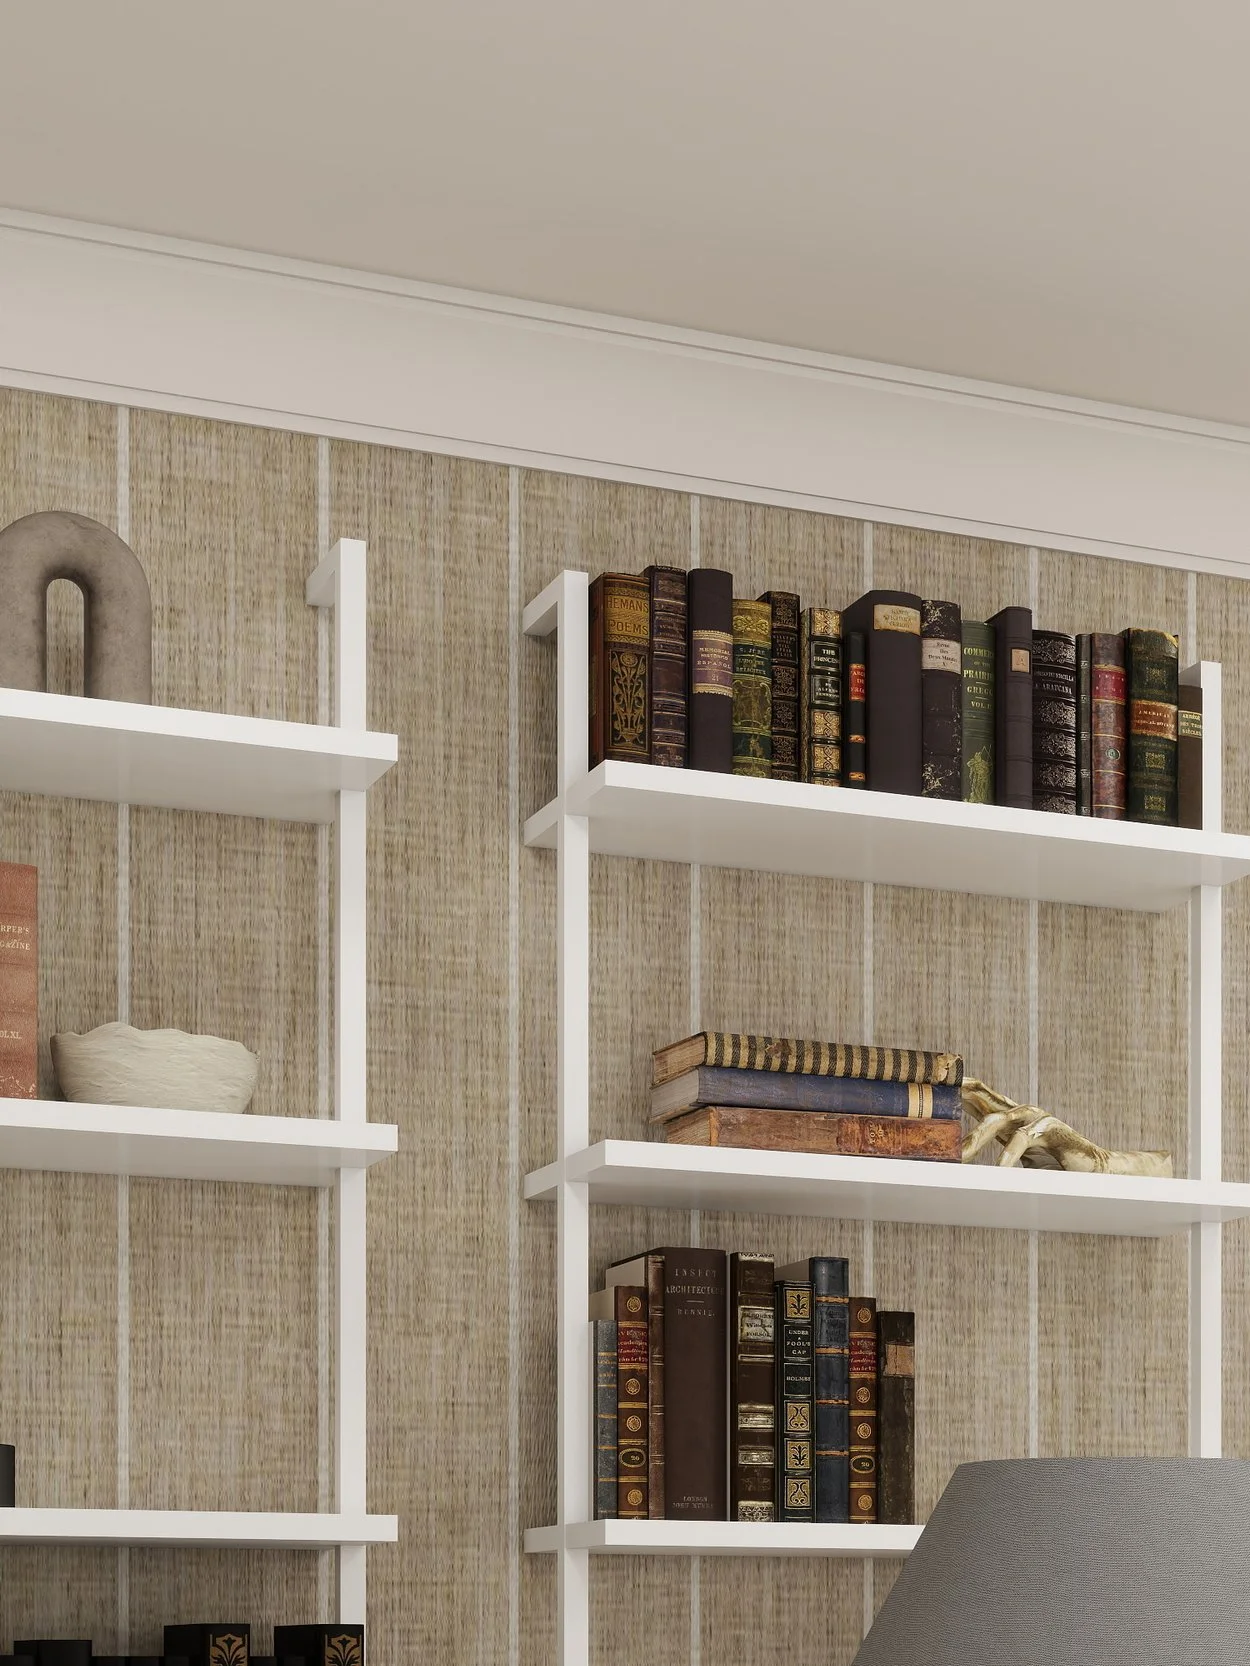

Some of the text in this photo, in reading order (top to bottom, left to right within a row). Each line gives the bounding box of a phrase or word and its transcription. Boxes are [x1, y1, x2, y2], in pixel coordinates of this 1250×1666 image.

[607, 597, 649, 613] HEMANS
[608, 620, 648, 635] POEMS
[0, 925, 29, 934] RPER'S
[0, 939, 31, 950] GAZINE
